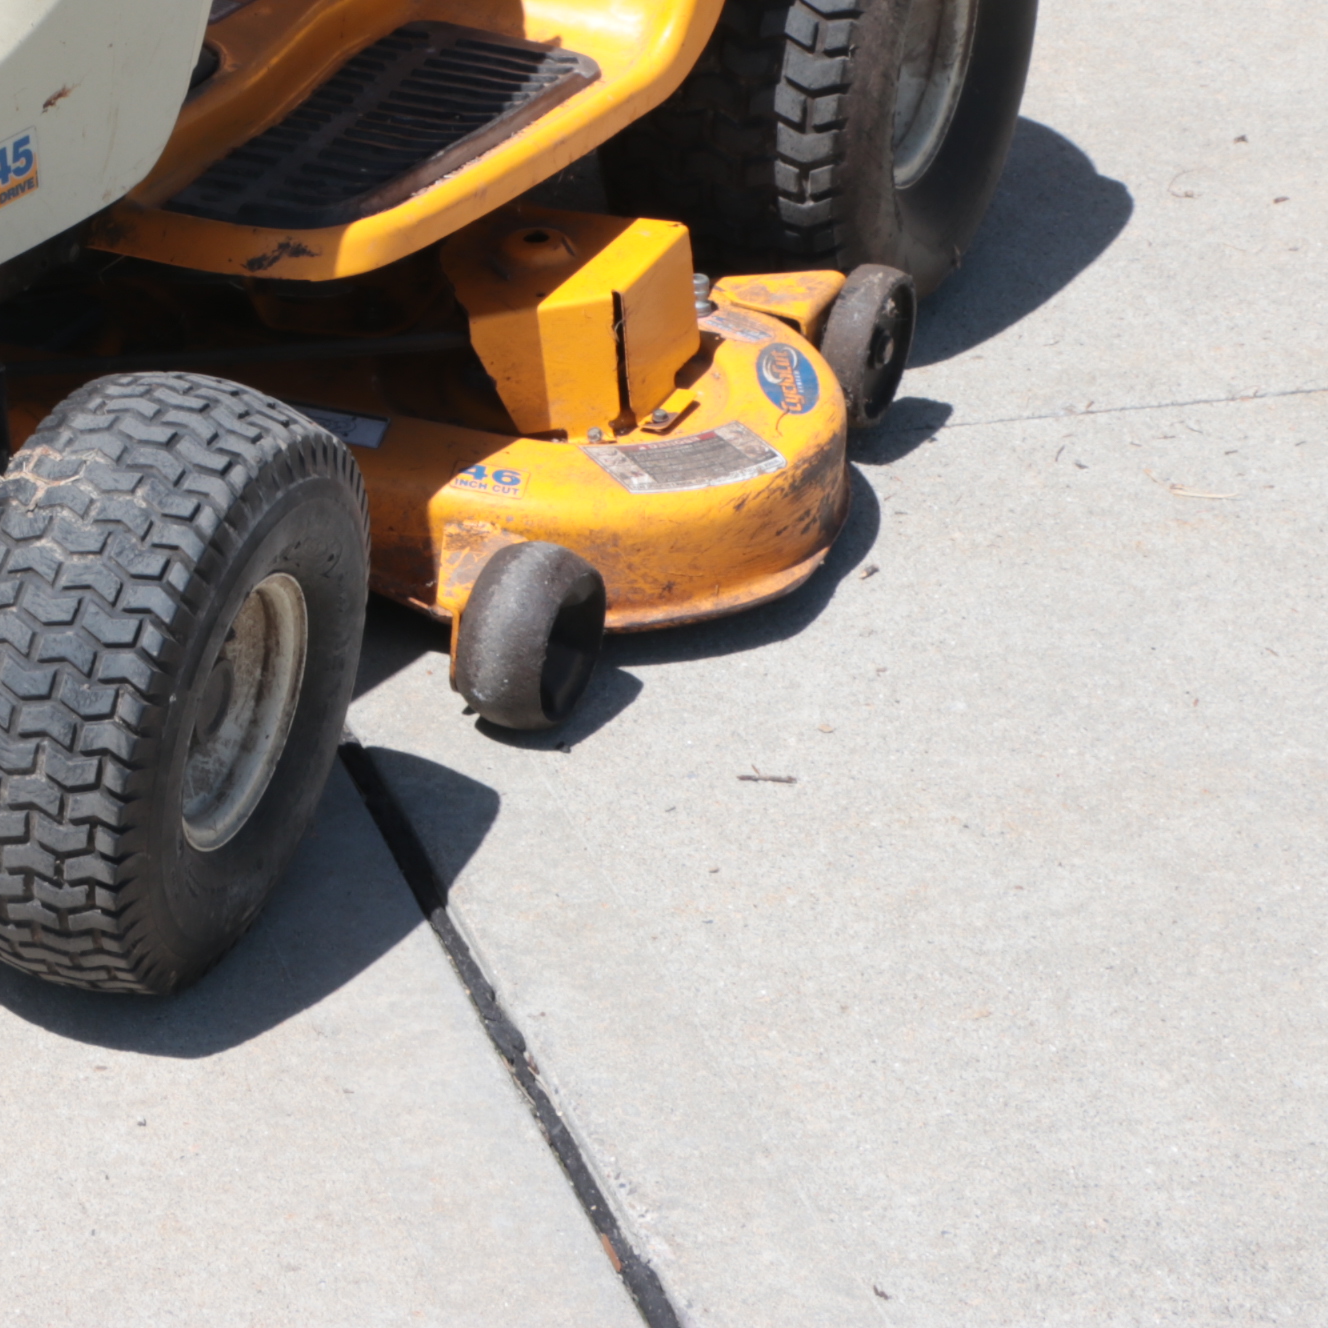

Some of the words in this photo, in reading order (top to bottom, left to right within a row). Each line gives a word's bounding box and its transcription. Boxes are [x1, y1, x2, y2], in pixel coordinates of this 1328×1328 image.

[0, 176, 35, 205] DRIVE
[458, 464, 521, 486] 46
[455, 478, 487, 490] INCH
[492, 484, 519, 496] CUT
